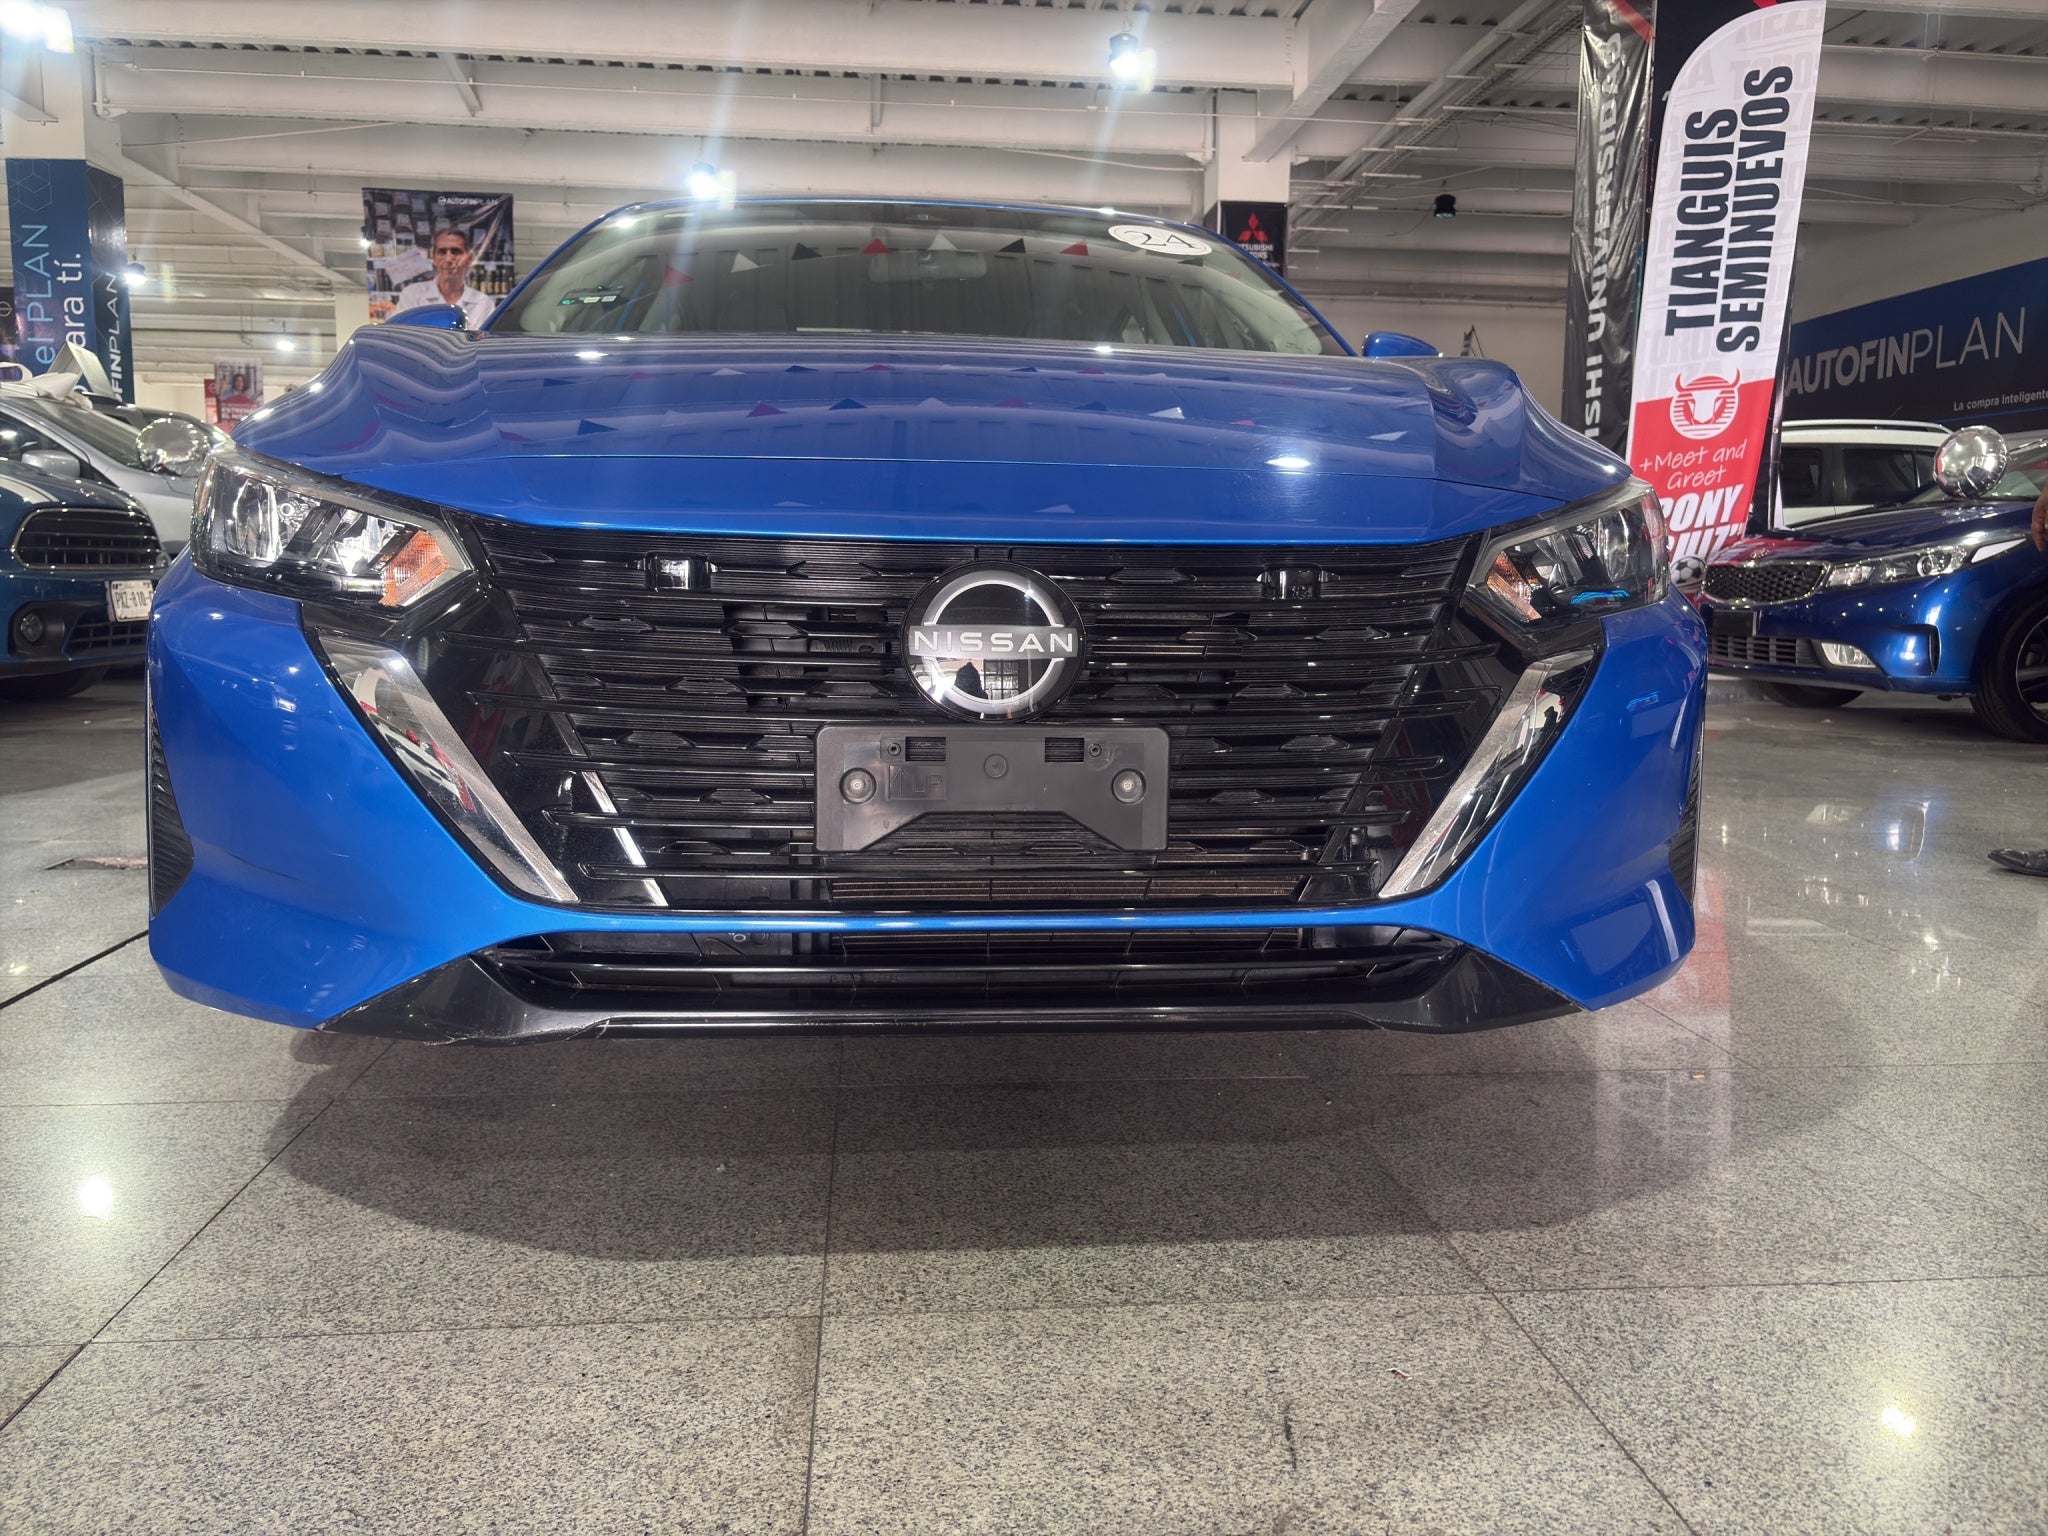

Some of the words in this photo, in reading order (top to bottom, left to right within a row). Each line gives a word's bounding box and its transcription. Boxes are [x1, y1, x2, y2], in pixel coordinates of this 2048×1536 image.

[1665, 108, 1738, 336] TIANGUIS
[1716, 66, 1793, 352] SEMINUEVOS
[21, 224, 54, 322] PLAN
[54, 253, 82, 284] tí.
[64, 296, 86, 349] ara
[105, 272, 123, 402] FINPLAN
[27, 339, 56, 365] el
[1785, 306, 2026, 397] AUTOFINPLAN
[1953, 401, 1964, 412] La
[1966, 397, 1999, 410] compra
[1712, 439, 1748, 464] and
[1667, 465, 1727, 490] Greet
[914, 631, 1073, 653] NISSAN
